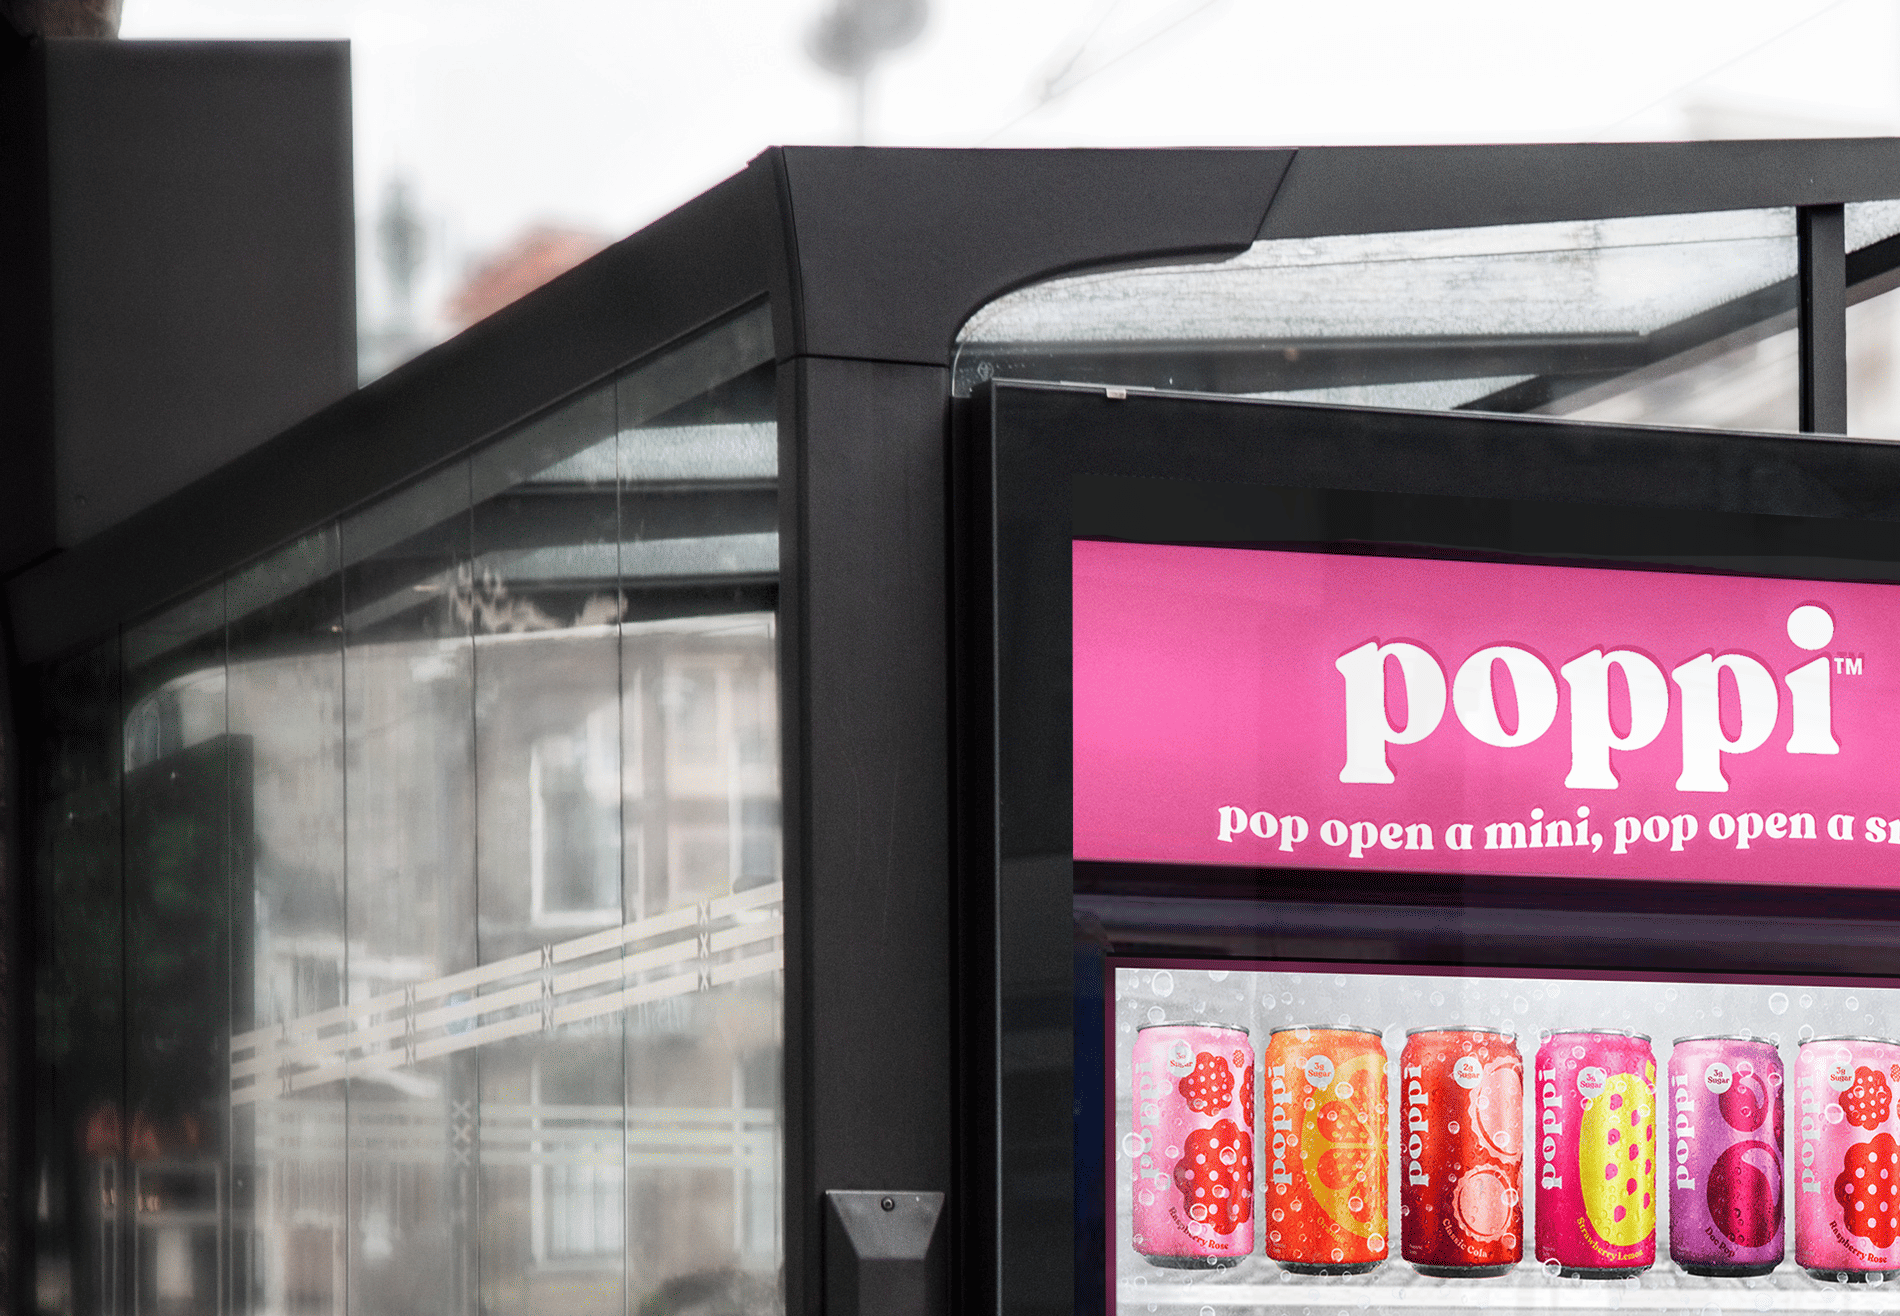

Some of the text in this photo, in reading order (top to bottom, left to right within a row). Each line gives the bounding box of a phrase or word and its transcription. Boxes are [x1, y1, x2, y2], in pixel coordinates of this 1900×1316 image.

[1335, 605, 1840, 792] poppi
[1217, 805, 1309, 852] pop
[1319, 819, 1434, 859] open
[1444, 823, 1474, 850] a
[1484, 805, 1603, 853] mini,
[1613, 814, 1698, 854] pop
[1708, 812, 1817, 849] open
[1827, 814, 1855, 841] a
[1308, 1070, 1331, 1078] Sugar
[1457, 1070, 1480, 1079] Sugar
[1463, 1064, 1473, 1072] 2g
[1580, 1081, 1602, 1089] Sugar
[1586, 1074, 1596, 1082] 3g
[1708, 1076, 1729, 1084] Sugar
[1830, 1074, 1852, 1082] Sugar
[1836, 1067, 1845, 1075] 3g
[1136, 1061, 1159, 1180] poppi
[1268, 1064, 1292, 1185] poppi
[1404, 1064, 1429, 1187] poppi
[1539, 1068, 1562, 1189] poppi
[1672, 1074, 1695, 1190] poppi
[1798, 1075, 1821, 1194] poppi
[1209, 1240, 1229, 1249] Rose
[1443, 1219, 1466, 1250] Classic
[1467, 1246, 1487, 1258] Cola
[1577, 1217, 1643, 1261] Strawberry Lemon
[1705, 1227, 1735, 1258] Doc Pop
[1829, 1220, 1887, 1263] Raspberry Rose
